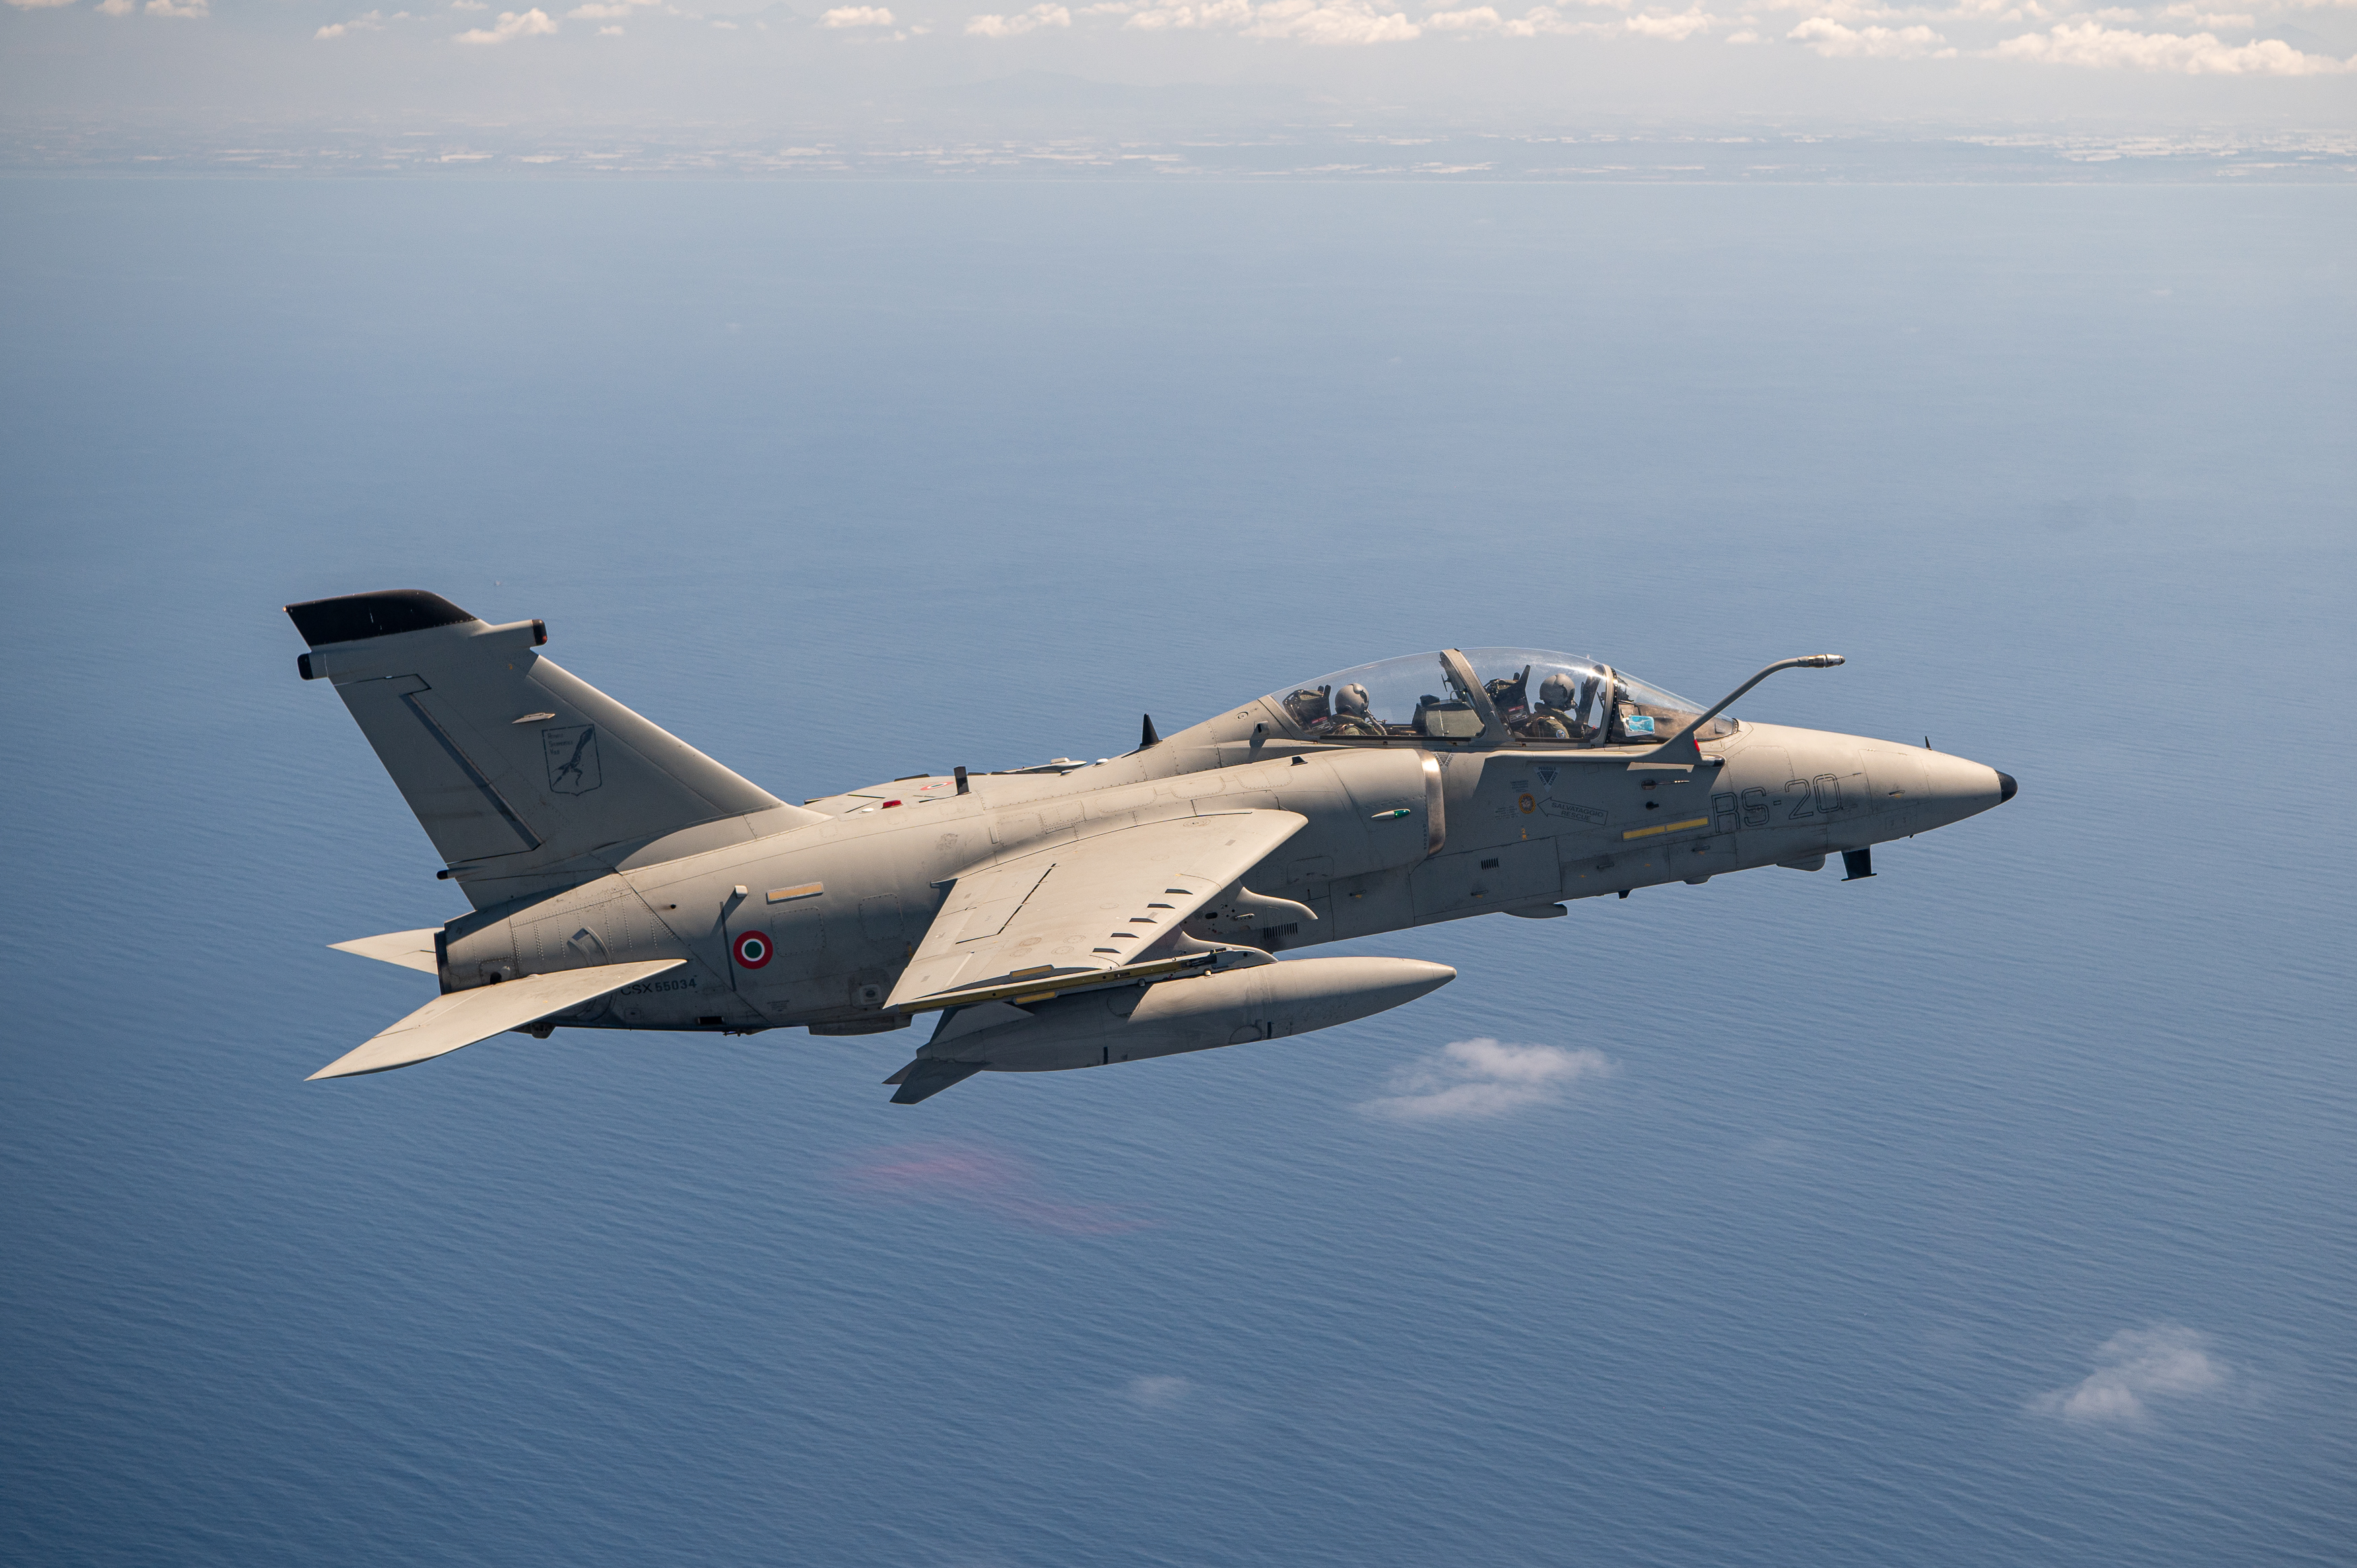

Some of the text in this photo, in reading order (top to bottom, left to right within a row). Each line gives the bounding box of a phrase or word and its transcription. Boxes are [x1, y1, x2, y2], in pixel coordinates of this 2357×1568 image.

[1551, 802, 1603, 817] SALVATAGGIO
[1711, 773, 1842, 833] RS-20
[1561, 810, 1591, 821] RESCUE
[620, 978, 697, 996] CSX 55034
